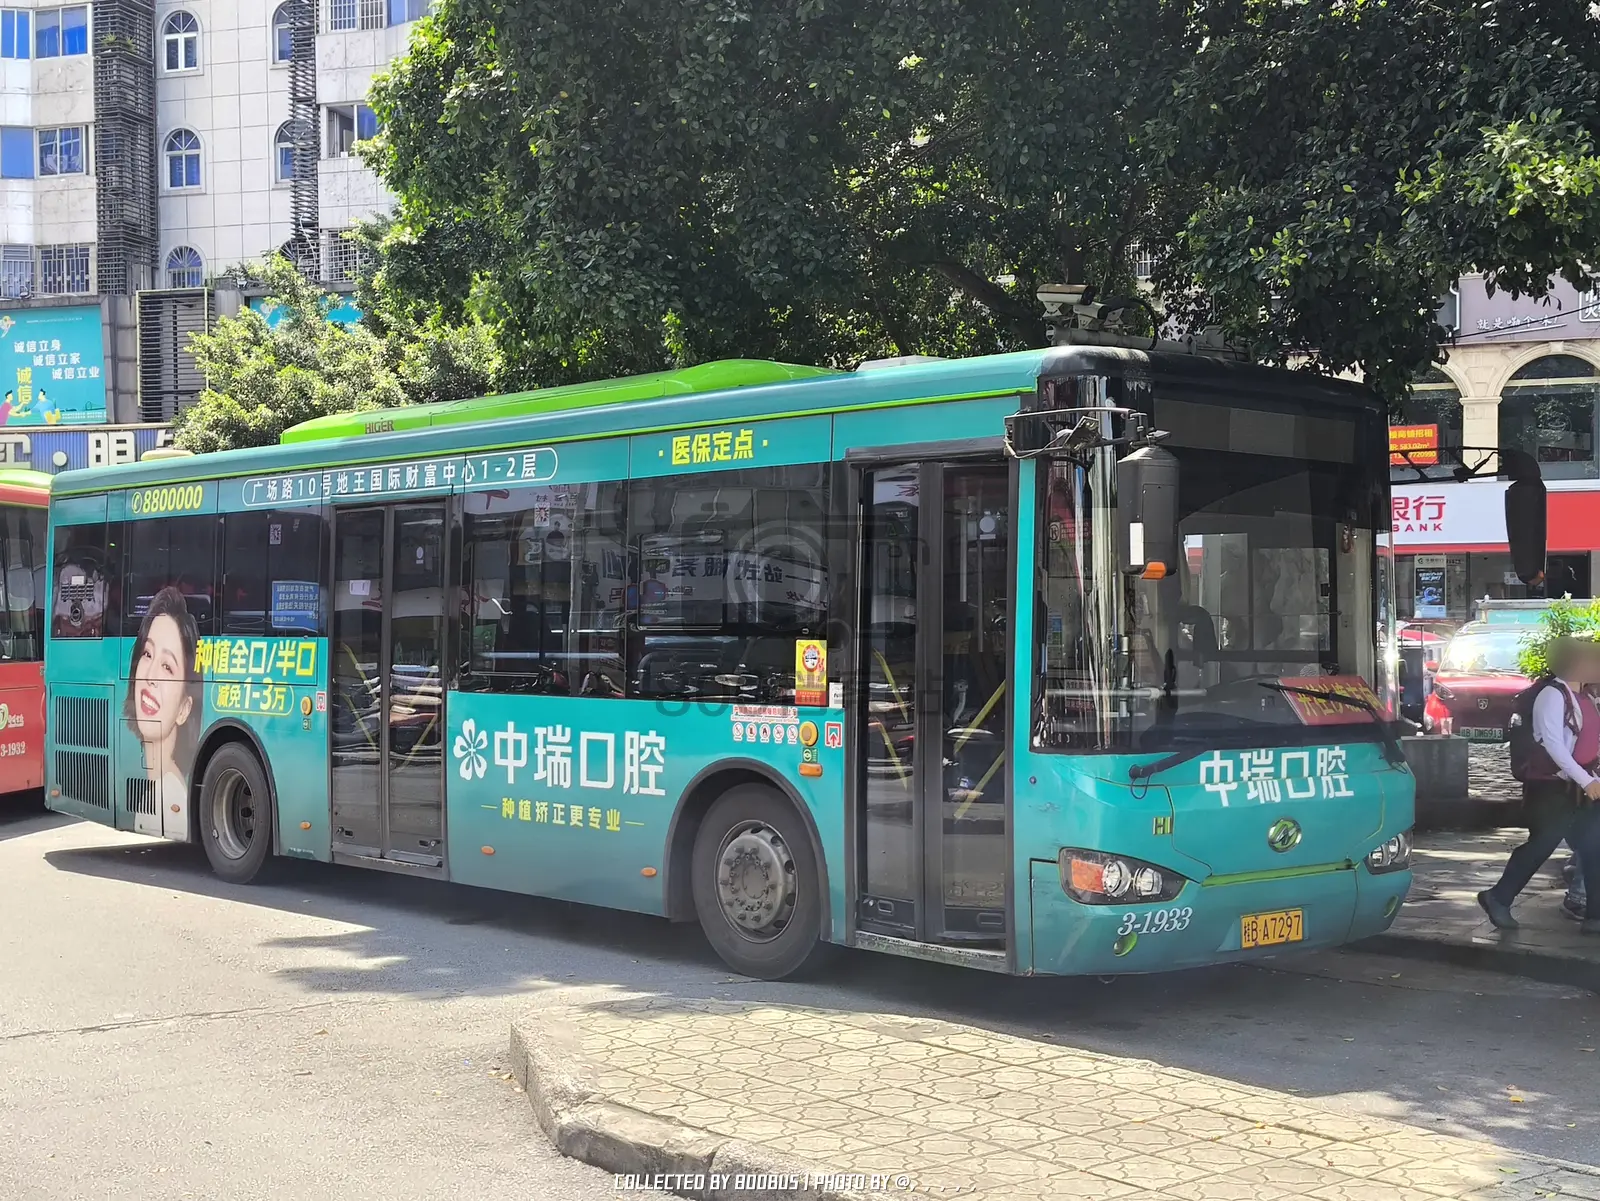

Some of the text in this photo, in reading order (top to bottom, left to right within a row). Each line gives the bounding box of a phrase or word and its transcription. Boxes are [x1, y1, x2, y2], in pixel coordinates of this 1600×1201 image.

[14, 339, 61, 353] 诚信立身
[33, 352, 80, 366] 诚信立家
[17, 367, 32, 404] 诚信
[52, 366, 100, 380] 诚信立业
[365, 420, 394, 434] HIGER
[671, 429, 754, 465] 医保定点
[252, 453, 537, 503] 广场路10号地王国际财富中心1-2层
[142, 485, 203, 513] 8800000
[1393, 523, 1442, 532] BANK
[194, 638, 316, 677] 种植全口/半口
[217, 677, 286, 712] 减免1-3万
[493, 720, 667, 797] 中瑞口腔
[1200, 745, 1355, 807] 中瑞口腔
[501, 797, 621, 832] 种植矫正更专业
[1117, 907, 1193, 936] 3-1933
